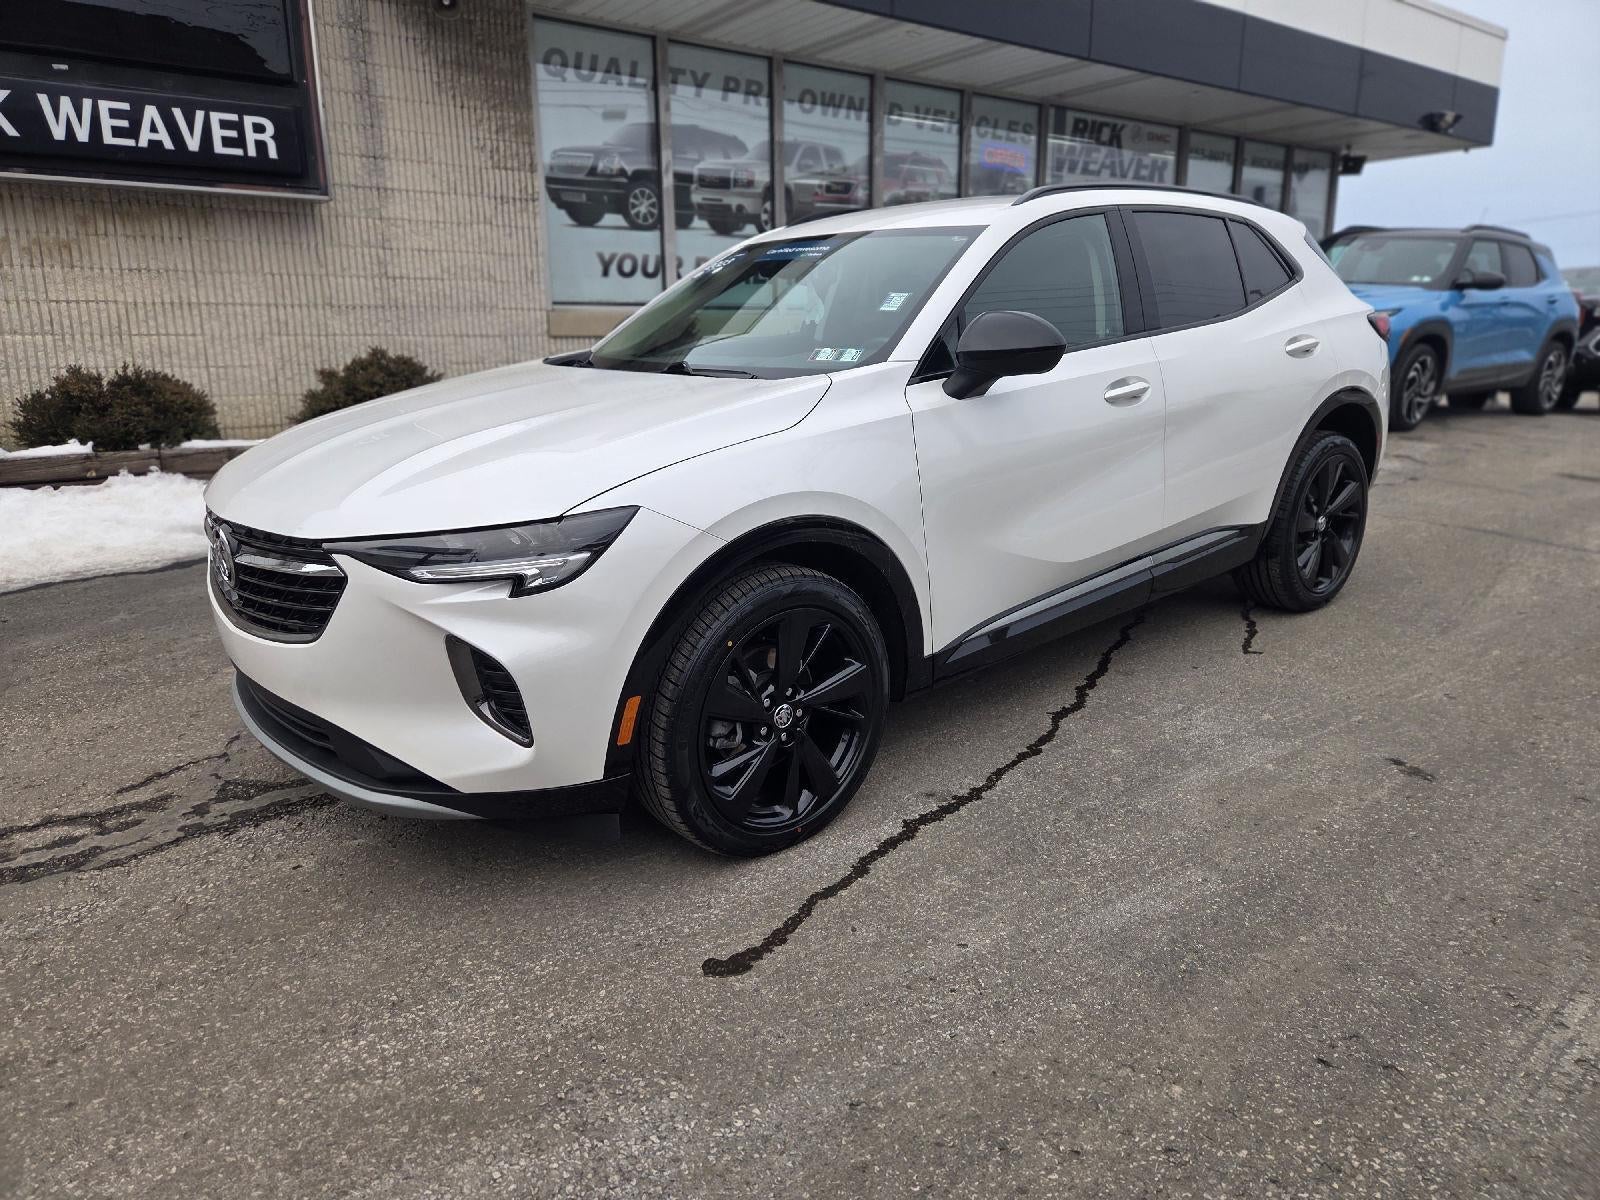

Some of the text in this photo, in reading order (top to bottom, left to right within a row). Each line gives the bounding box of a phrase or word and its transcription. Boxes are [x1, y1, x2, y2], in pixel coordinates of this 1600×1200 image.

[542, 47, 1036, 144] QUALTY PR-OWND VECLES
[36, 93, 279, 160] WEAVER
[1072, 117, 1127, 149] RICK
[1053, 143, 1168, 183] WEAVER
